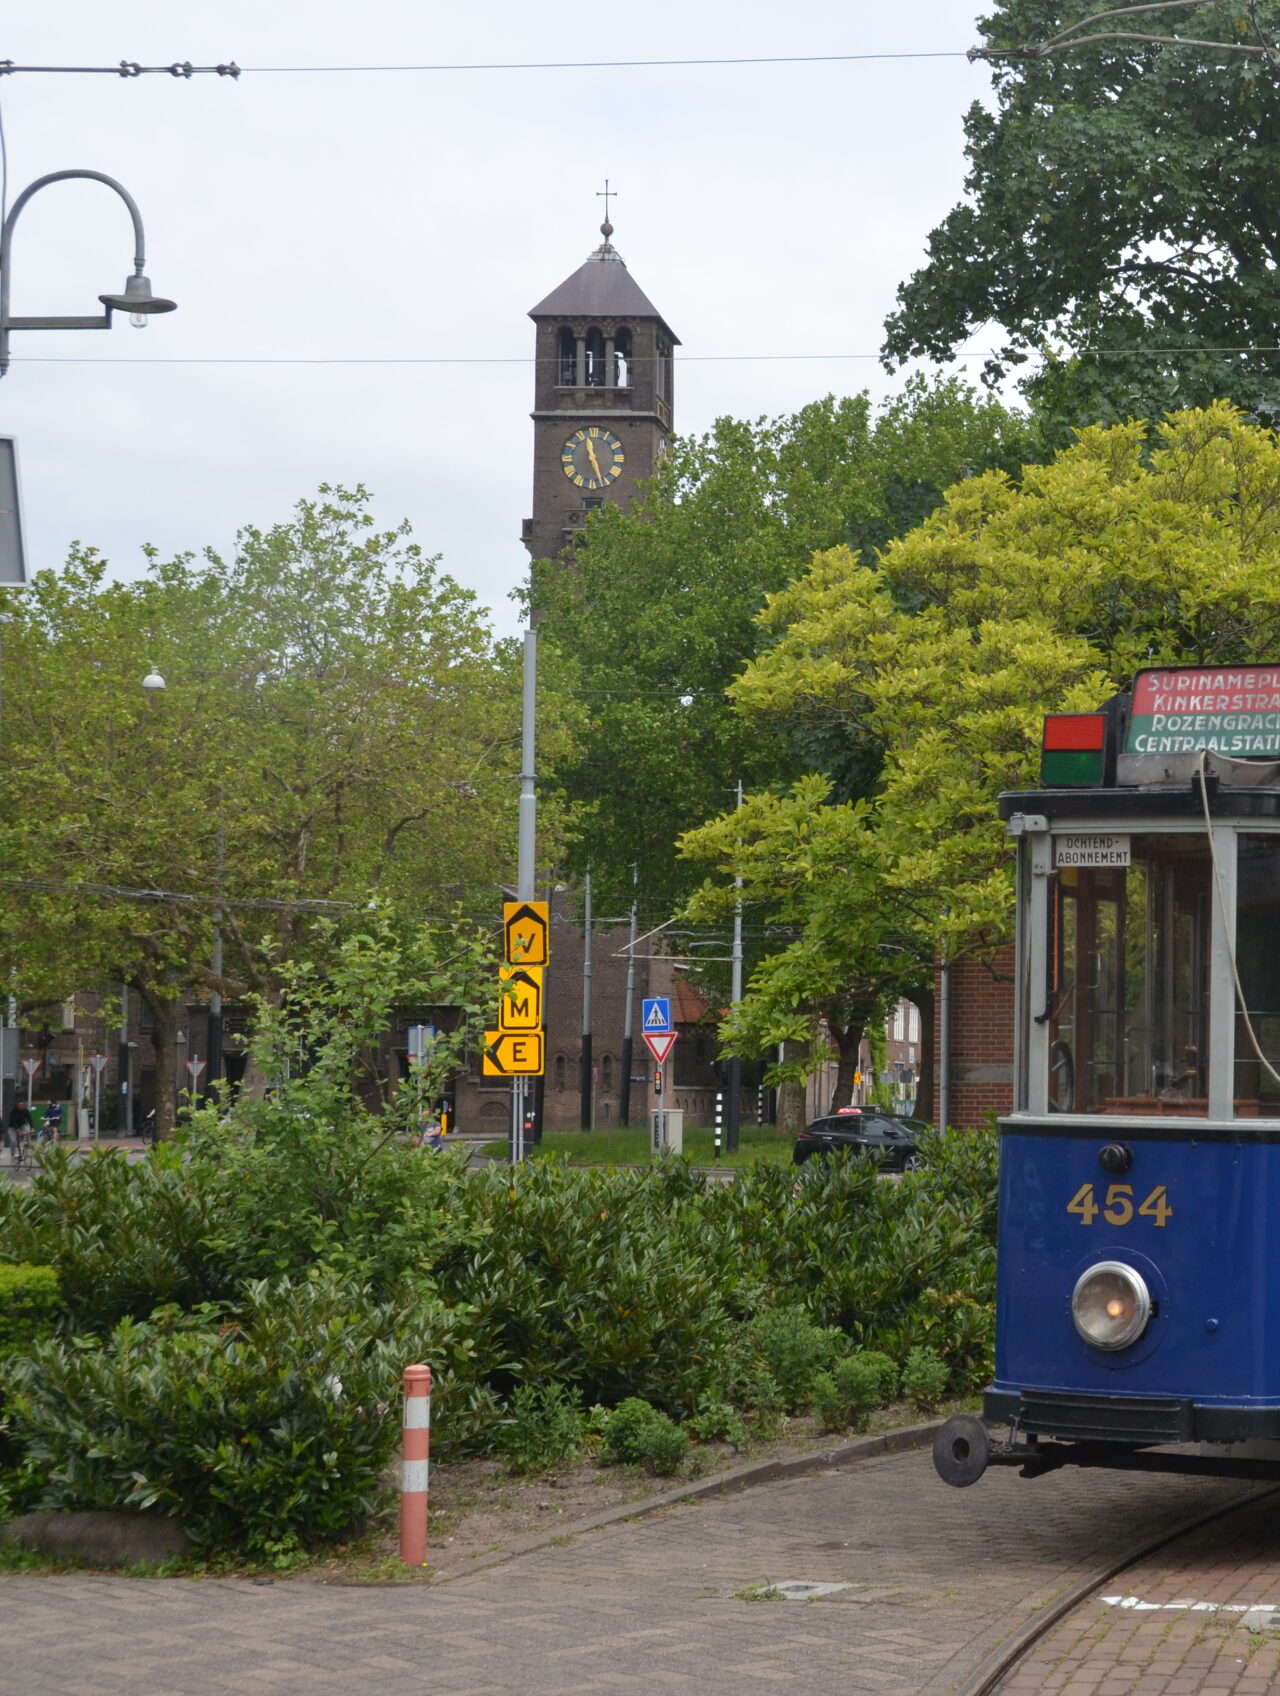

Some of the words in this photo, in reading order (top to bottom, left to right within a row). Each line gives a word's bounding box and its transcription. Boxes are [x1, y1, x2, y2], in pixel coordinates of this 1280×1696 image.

[1058, 851, 1128, 864] ABONNEMENT
[517, 932, 536, 954] V
[510, 997, 529, 1018] M
[513, 1042, 527, 1062] E
[1066, 1183, 1173, 1227] 454
